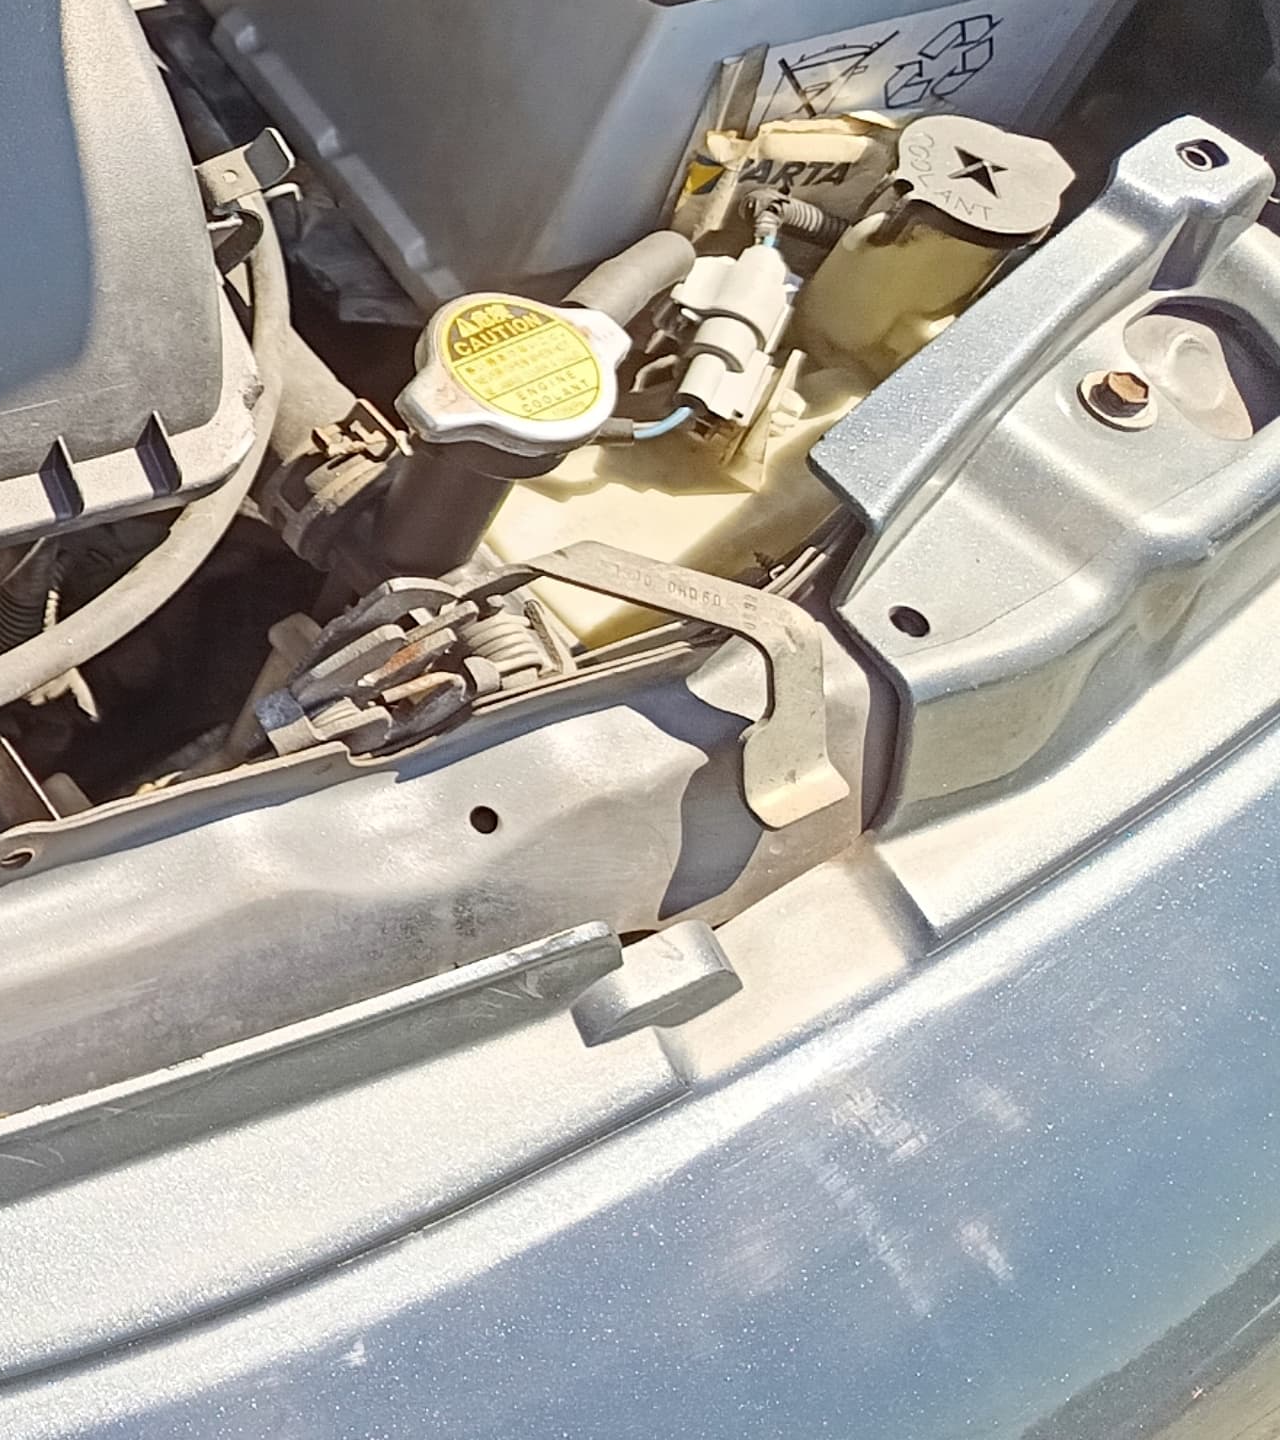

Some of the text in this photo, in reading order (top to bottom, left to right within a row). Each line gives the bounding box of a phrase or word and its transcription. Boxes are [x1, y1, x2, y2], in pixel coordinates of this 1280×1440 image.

[907, 132, 993, 222] COOLANT
[453, 312, 543, 357] CAUTION
[515, 369, 578, 401] ENGINE
[521, 378, 590, 413] COOLANT
